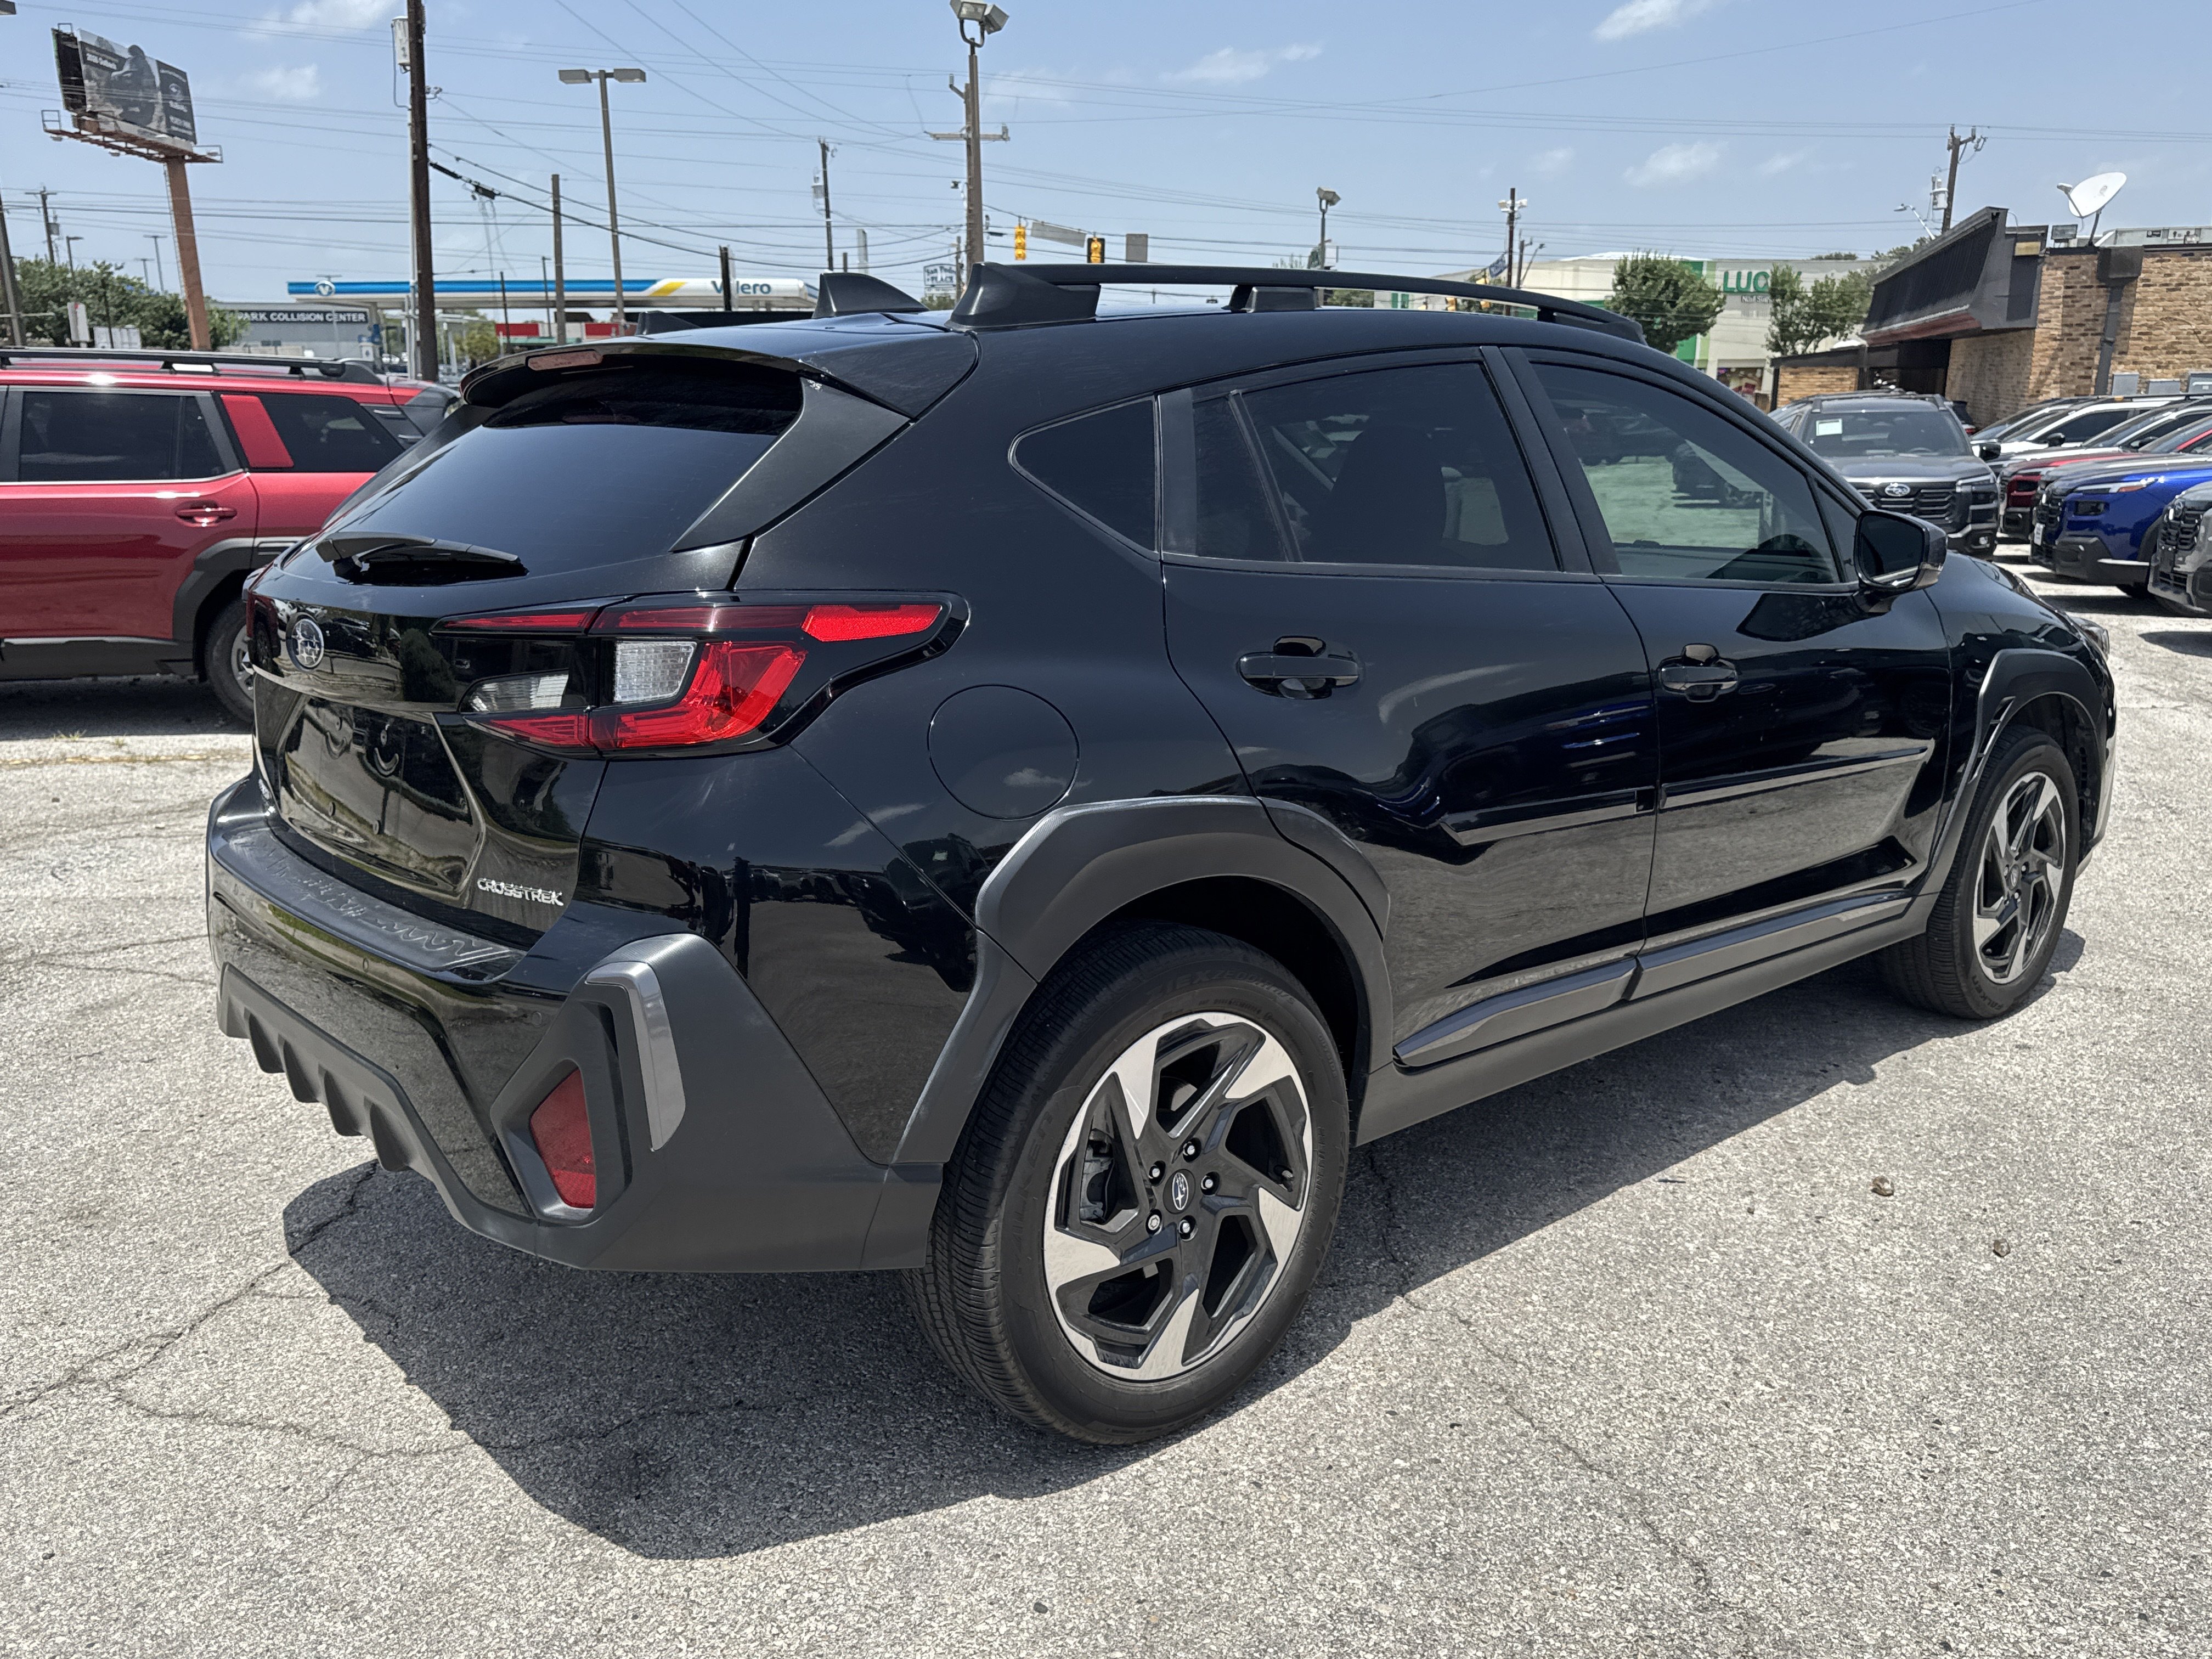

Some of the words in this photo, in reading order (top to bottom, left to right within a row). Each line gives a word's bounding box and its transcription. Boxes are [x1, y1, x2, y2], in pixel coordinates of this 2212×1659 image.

[711, 280, 771, 294] Vlero
[269, 312, 323, 321] COLLISION
[325, 313, 366, 322] CENTER
[477, 878, 564, 906] CROSSTREK
